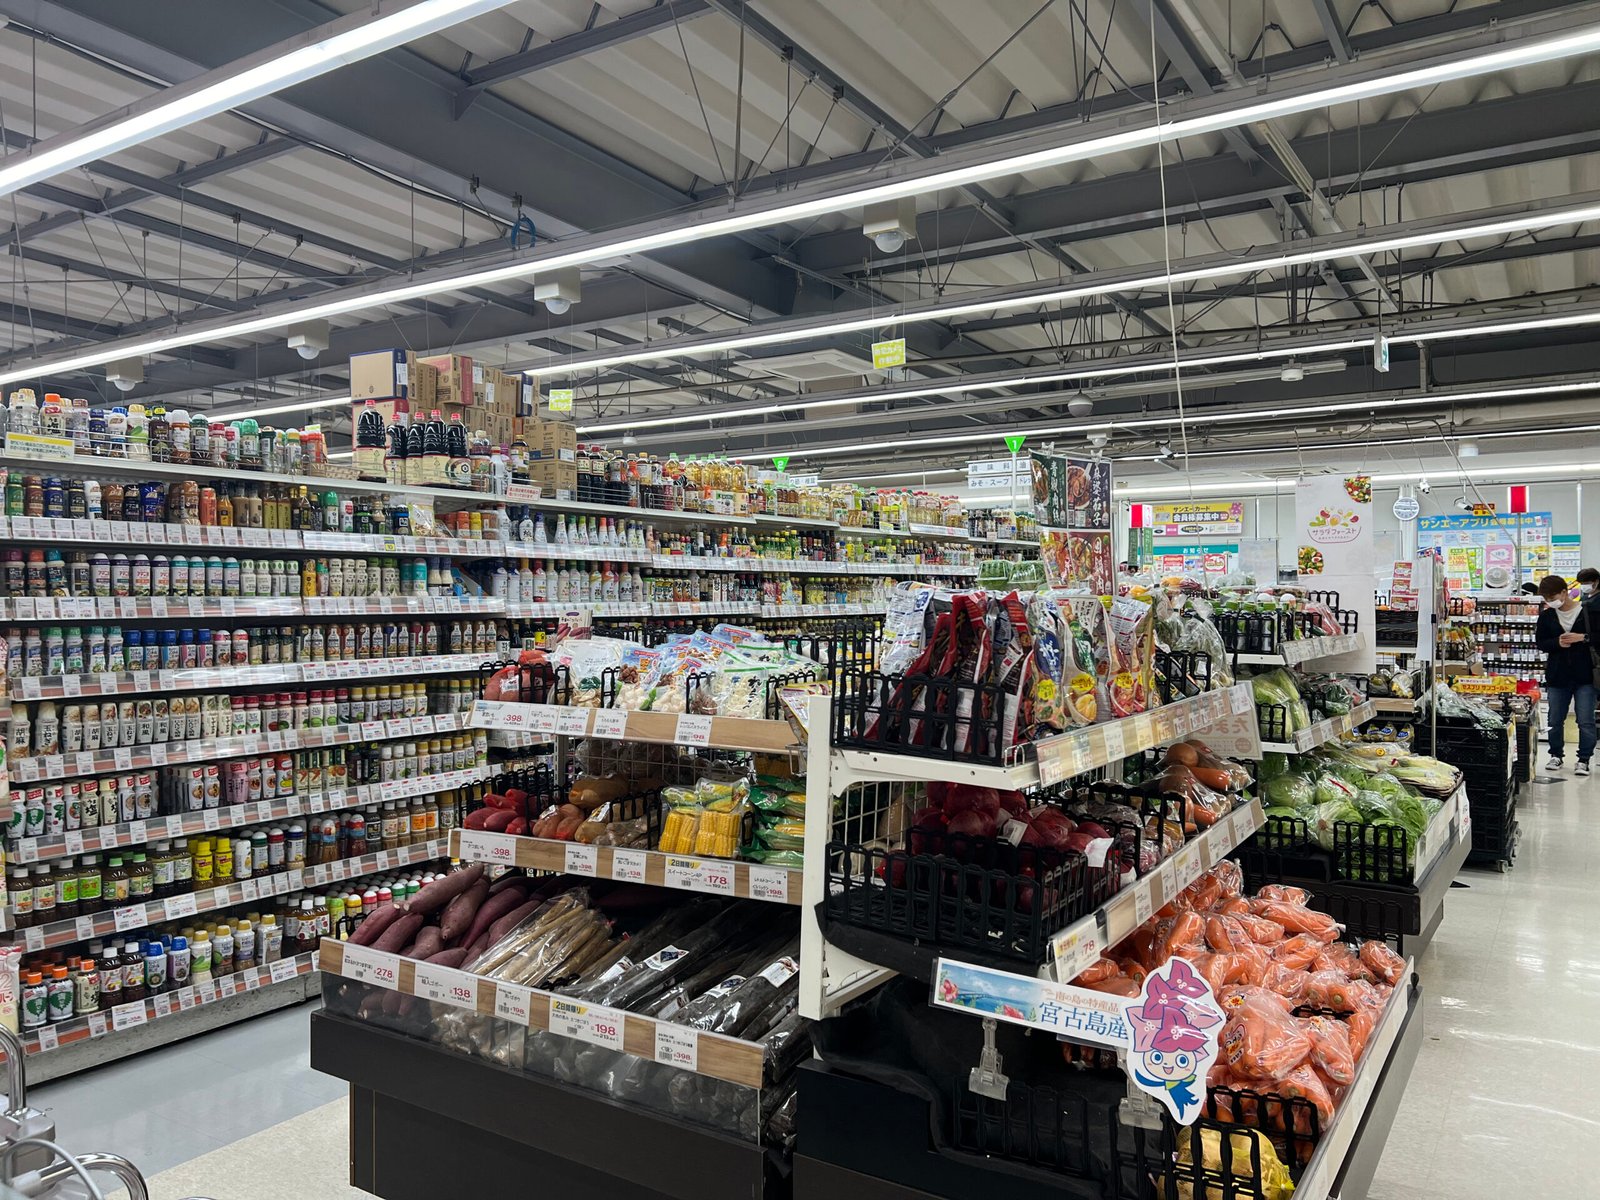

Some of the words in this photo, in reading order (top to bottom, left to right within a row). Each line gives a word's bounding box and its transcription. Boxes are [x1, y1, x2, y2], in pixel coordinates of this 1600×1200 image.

[1012, 440, 1017, 450] 1
[777, 461, 784, 469] 2
[971, 477, 1010, 488] みそ・スープ
[1173, 513, 1219, 522] 会員様募集中
[1312, 528, 1357, 536] サラダファースト
[506, 714, 522, 723] 398
[141, 723, 150, 736] 和風
[159, 722, 168, 734] 和風
[15, 728, 26, 744] 胡麻
[91, 728, 99, 741] 胡麻
[494, 847, 510, 857] 398
[671, 858, 695, 869] 2日間限り
[708, 875, 728, 885] 178
[1083, 940, 1095, 954] 78
[377, 967, 393, 979] 278
[453, 987, 471, 999] 138
[1055, 990, 1119, 1013] 南の島の特産品
[512, 1006, 525, 1015] 198
[555, 1000, 582, 1015] 2日間限り
[1039, 1001, 1129, 1040] 宮古島産
[594, 1023, 616, 1036] 198
[676, 1051, 691, 1060] 398
